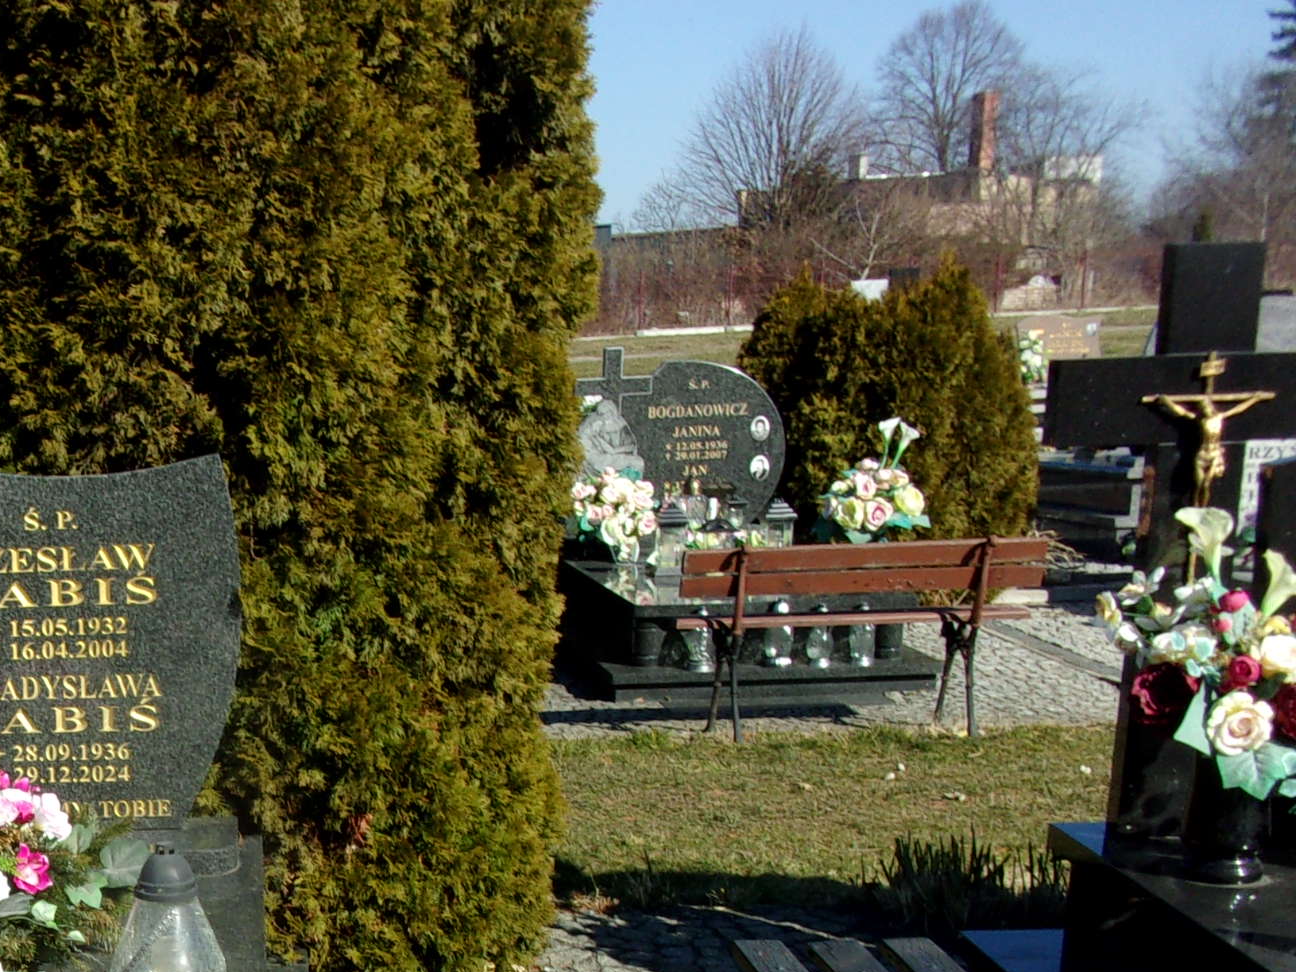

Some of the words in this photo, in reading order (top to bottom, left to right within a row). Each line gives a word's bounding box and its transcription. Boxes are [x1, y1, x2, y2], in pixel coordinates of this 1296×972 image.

[648, 402, 749, 420] BOGDANOWICZ
[672, 424, 721, 438] JANINA
[1248, 445, 1296, 461] RZY
[682, 465, 708, 477] JAN
[56, 511, 80, 530] P.
[9, 616, 128, 637] 15.05.1932
[9, 639, 129, 660] 16.04.2004
[12, 744, 130, 762] 28.09.1936
[13, 765, 131, 784] 29.12.2024
[99, 799, 172, 818] TOBIE
